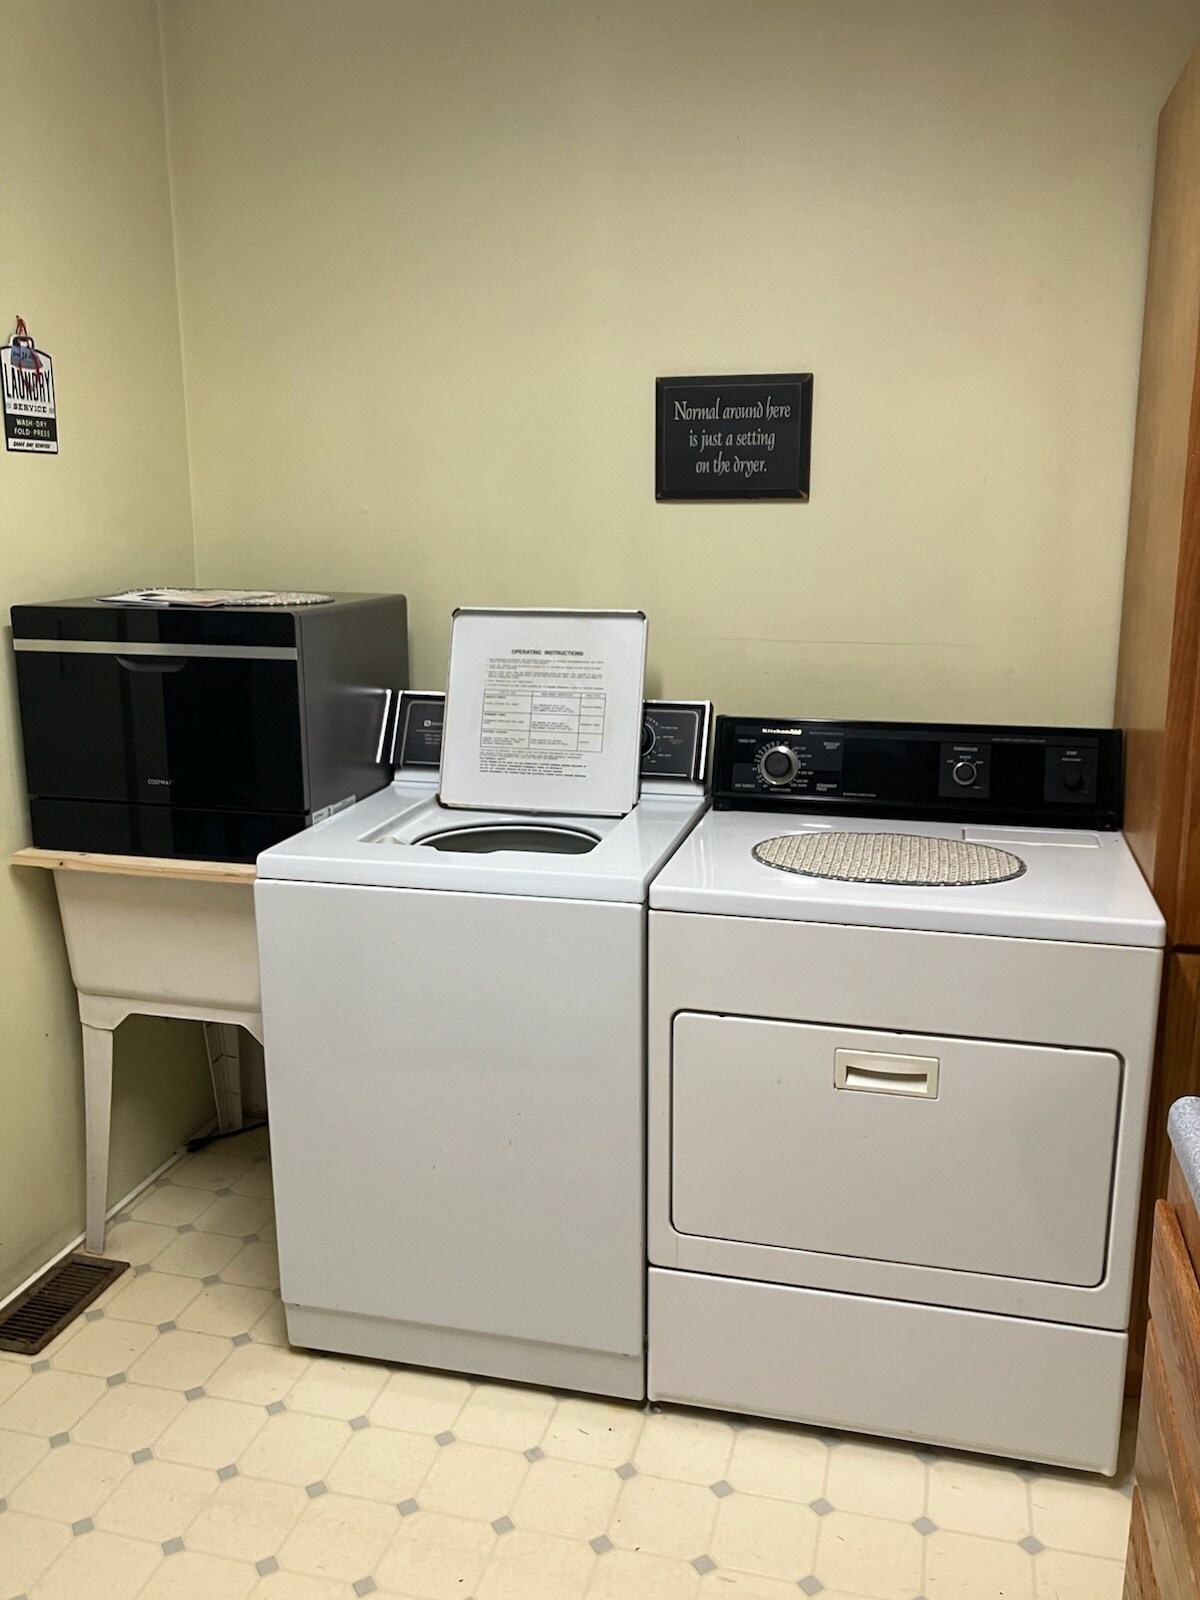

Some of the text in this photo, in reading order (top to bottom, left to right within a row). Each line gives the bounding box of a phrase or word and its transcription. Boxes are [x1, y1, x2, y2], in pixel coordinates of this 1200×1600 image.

[4, 363, 50, 403] LAUNDRY
[13, 403, 47, 413] SERVICE
[673, 395, 791, 421] Normal around here
[15, 418, 47, 428] WASH DRY
[14, 427, 50, 438] FOLD PRESS
[689, 428, 776, 453] is just a setting
[695, 450, 768, 478] on the dryer.
[511, 648, 584, 657] OPERATING INSTRUCTIONS
